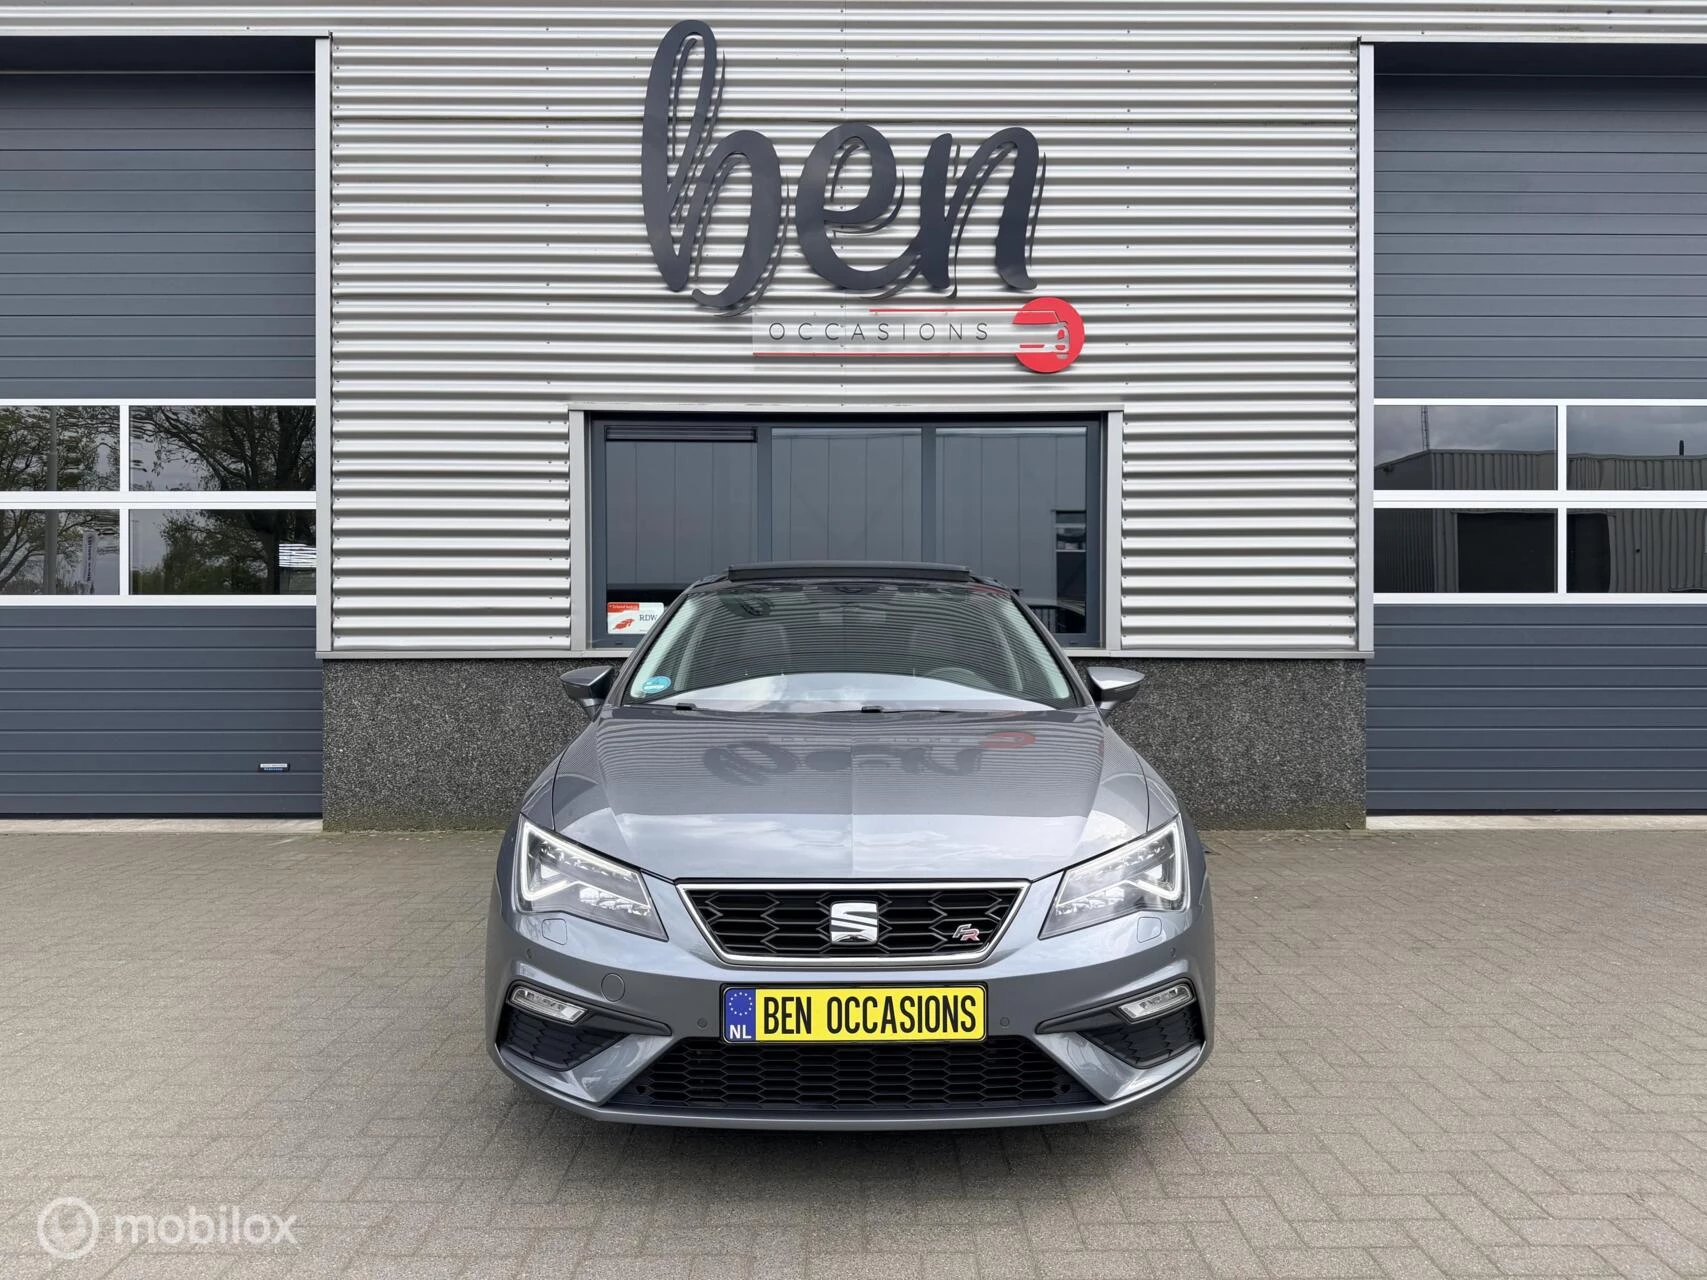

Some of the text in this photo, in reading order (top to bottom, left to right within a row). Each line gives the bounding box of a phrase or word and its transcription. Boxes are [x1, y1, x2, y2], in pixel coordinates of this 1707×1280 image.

[641, 19, 1046, 316] ben
[768, 322, 988, 341] OCCASIONS
[952, 923, 980, 941] FR
[763, 995, 977, 1035] BEN OCCASIONS
[729, 1024, 752, 1039] NL
